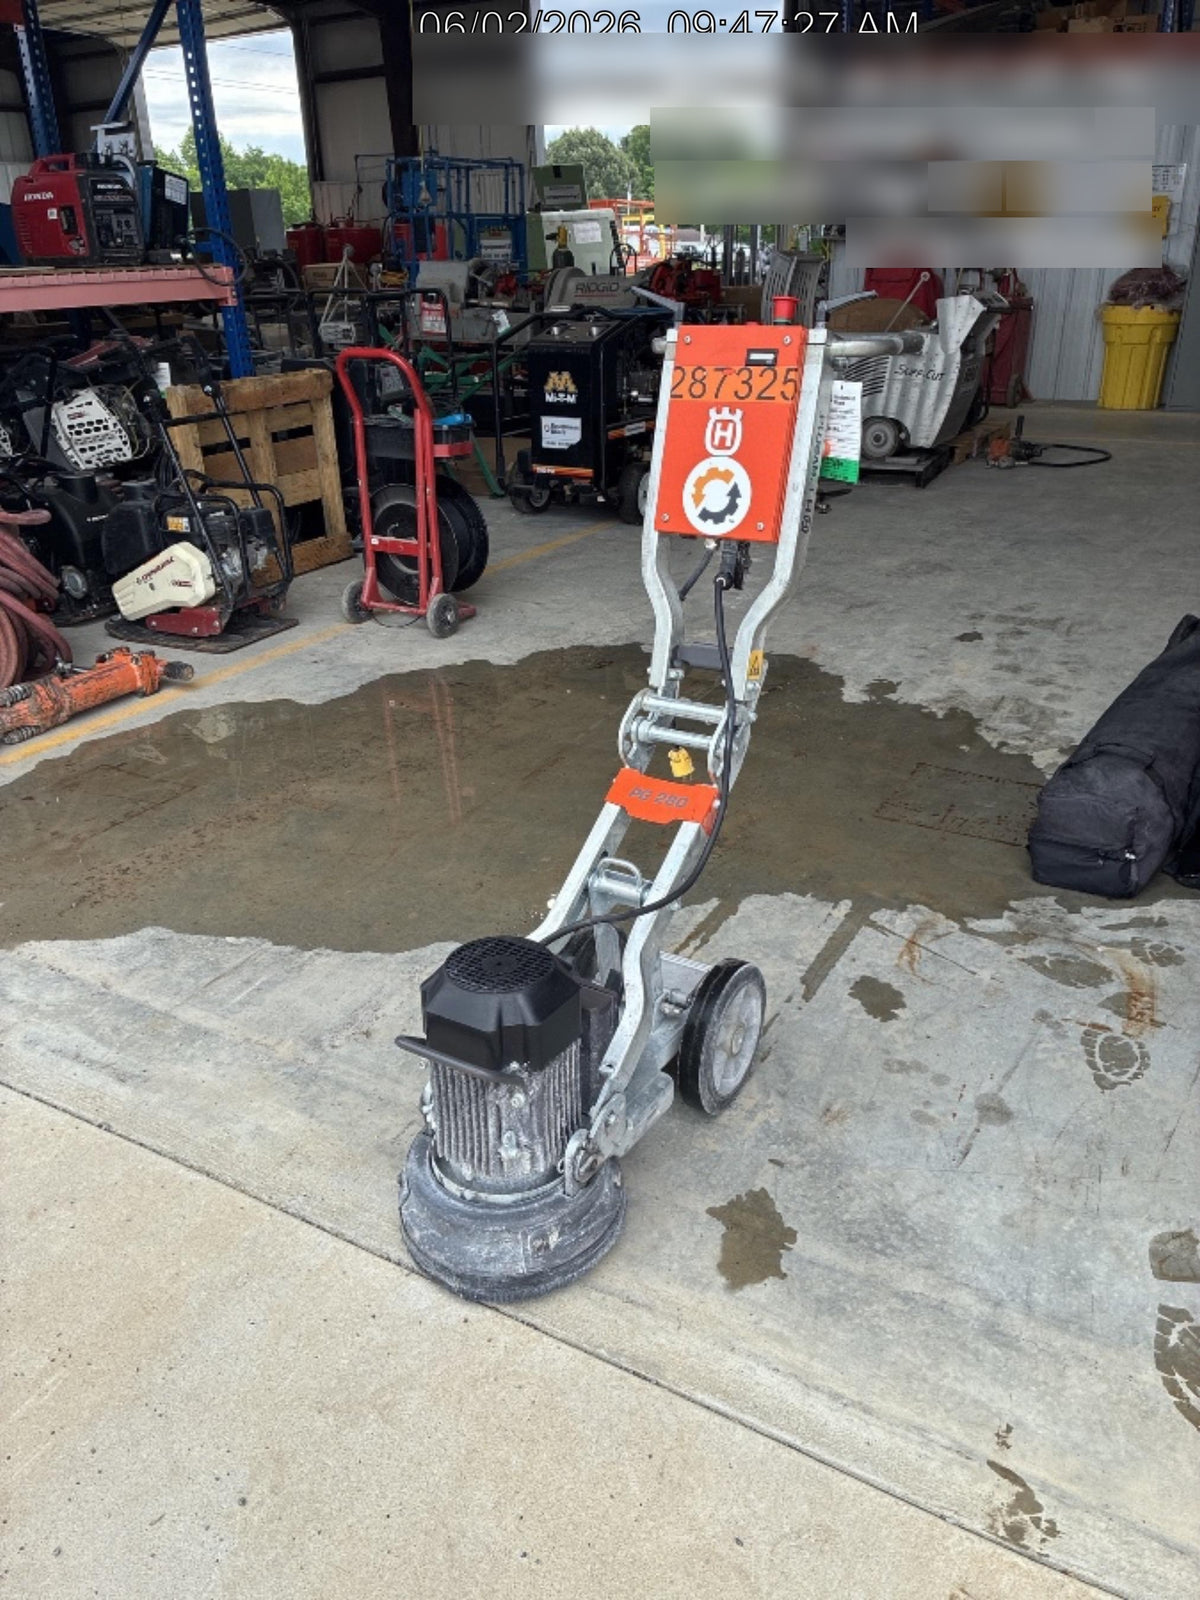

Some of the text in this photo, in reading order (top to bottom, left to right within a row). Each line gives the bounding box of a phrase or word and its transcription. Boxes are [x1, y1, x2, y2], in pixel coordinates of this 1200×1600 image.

[24, 192, 54, 202] HONDA
[574, 281, 619, 293] RIDGID
[670, 366, 799, 401] 287325
[629, 787, 688, 807] PG 280
